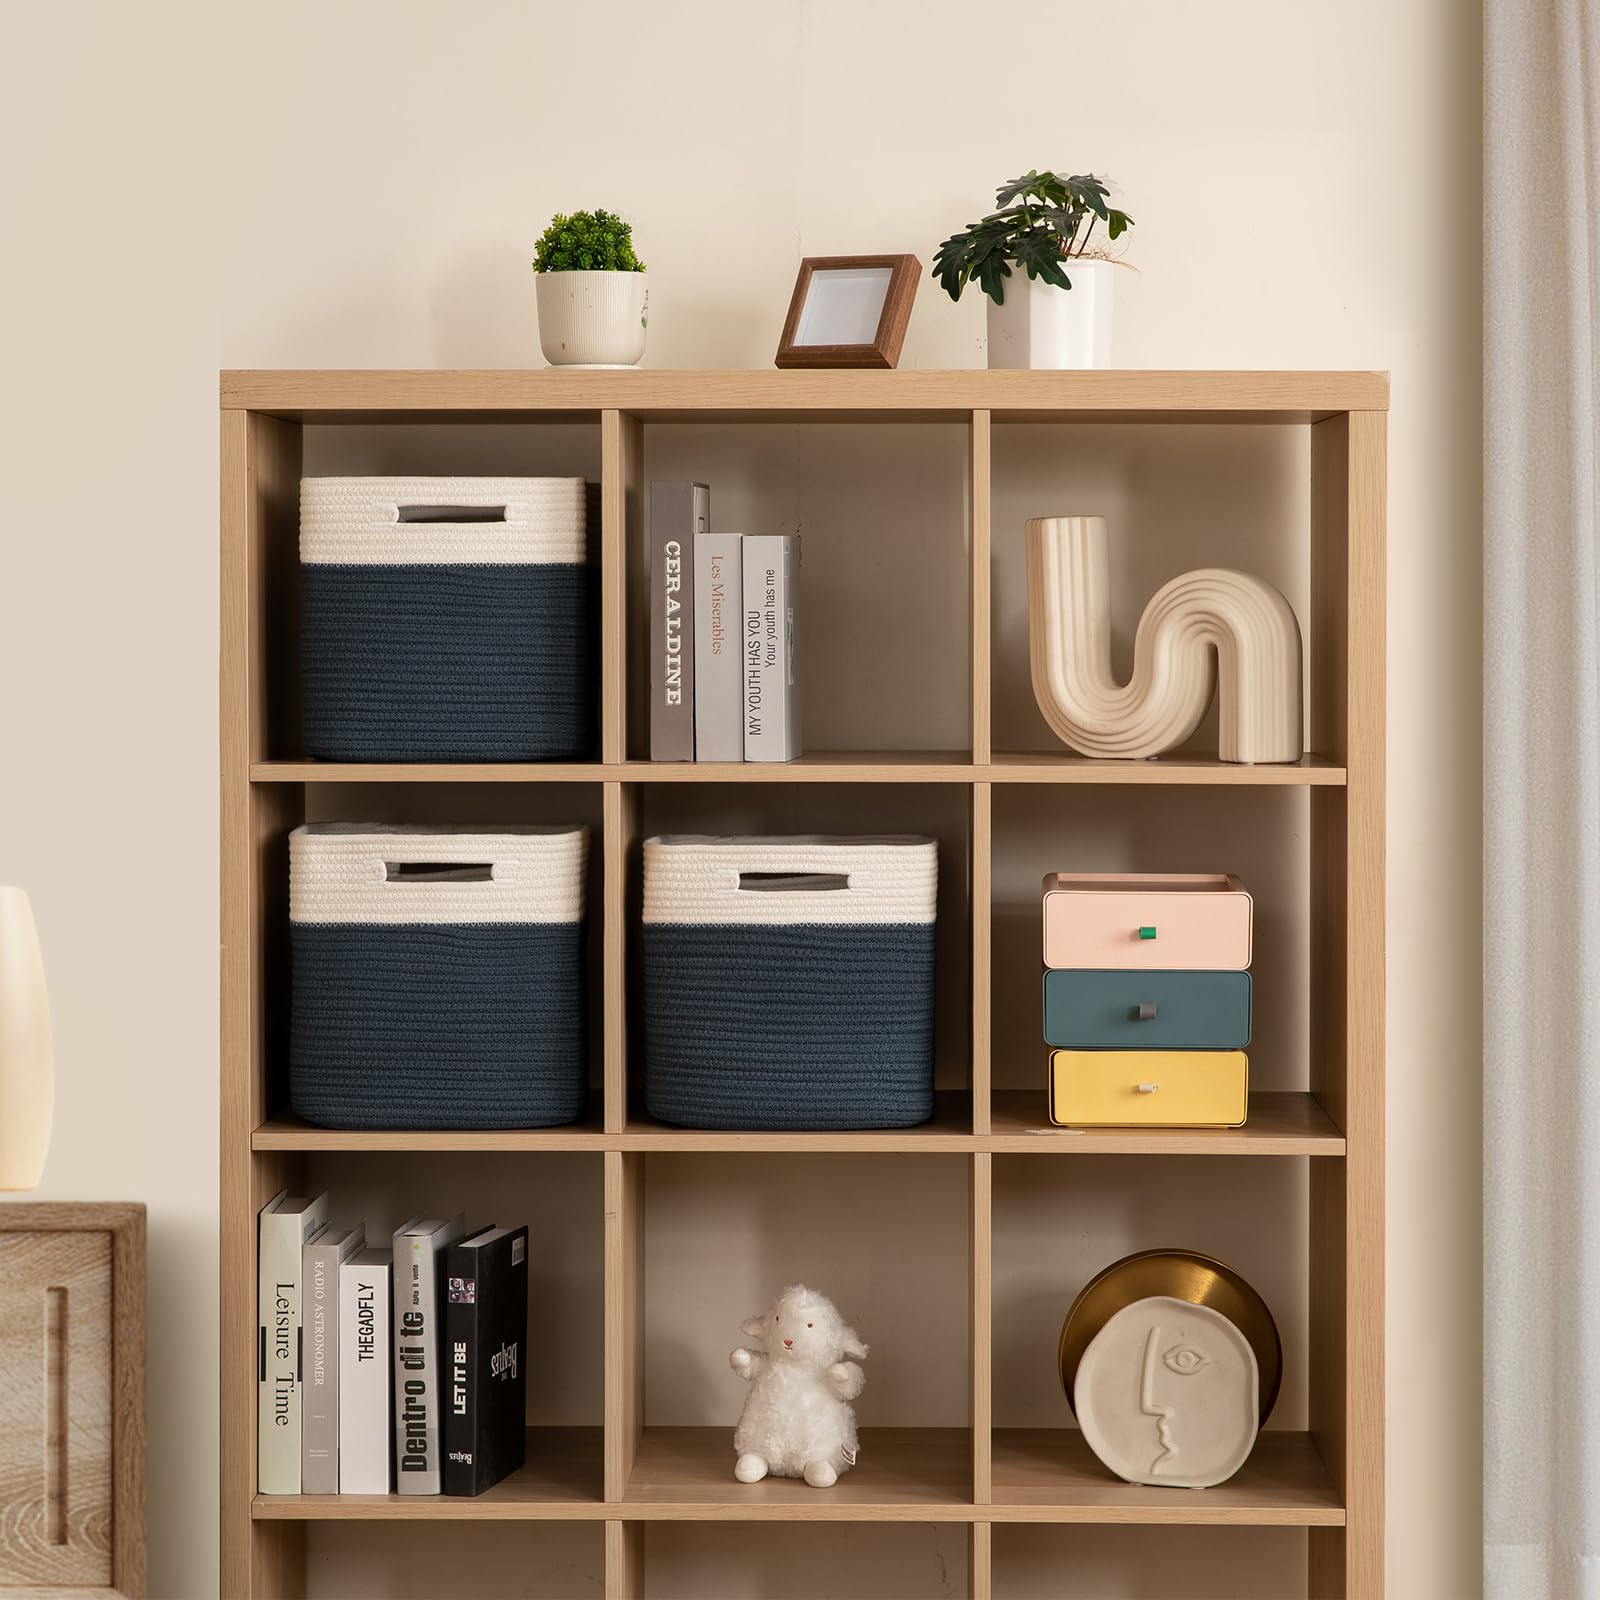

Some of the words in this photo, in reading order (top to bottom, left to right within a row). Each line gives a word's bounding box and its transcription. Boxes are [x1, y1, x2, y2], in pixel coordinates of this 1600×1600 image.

[711, 556, 724, 579] Les
[766, 569, 775, 586] me
[764, 588, 776, 608] has
[664, 540, 682, 706] CERALDINE
[711, 583, 725, 655] Miserables
[748, 610, 761, 638] YOU
[764, 610, 778, 641] youth
[748, 640, 761, 666] HAS
[764, 643, 777, 669] Your
[748, 669, 762, 713] YOUTH
[748, 715, 762, 736] MY
[314, 1261, 325, 1300] RADIO
[275, 1282, 295, 1360] Leisure
[357, 1282, 375, 1362] THEGADFLY
[400, 1311, 424, 1338] te
[314, 1303, 326, 1386] ASTRONOMER
[399, 1346, 425, 1371] di
[453, 1342, 467, 1364] BE
[453, 1366, 467, 1382] IT
[275, 1371, 295, 1427] Time
[453, 1384, 467, 1415] LET
[401, 1379, 428, 1473] Dentro
